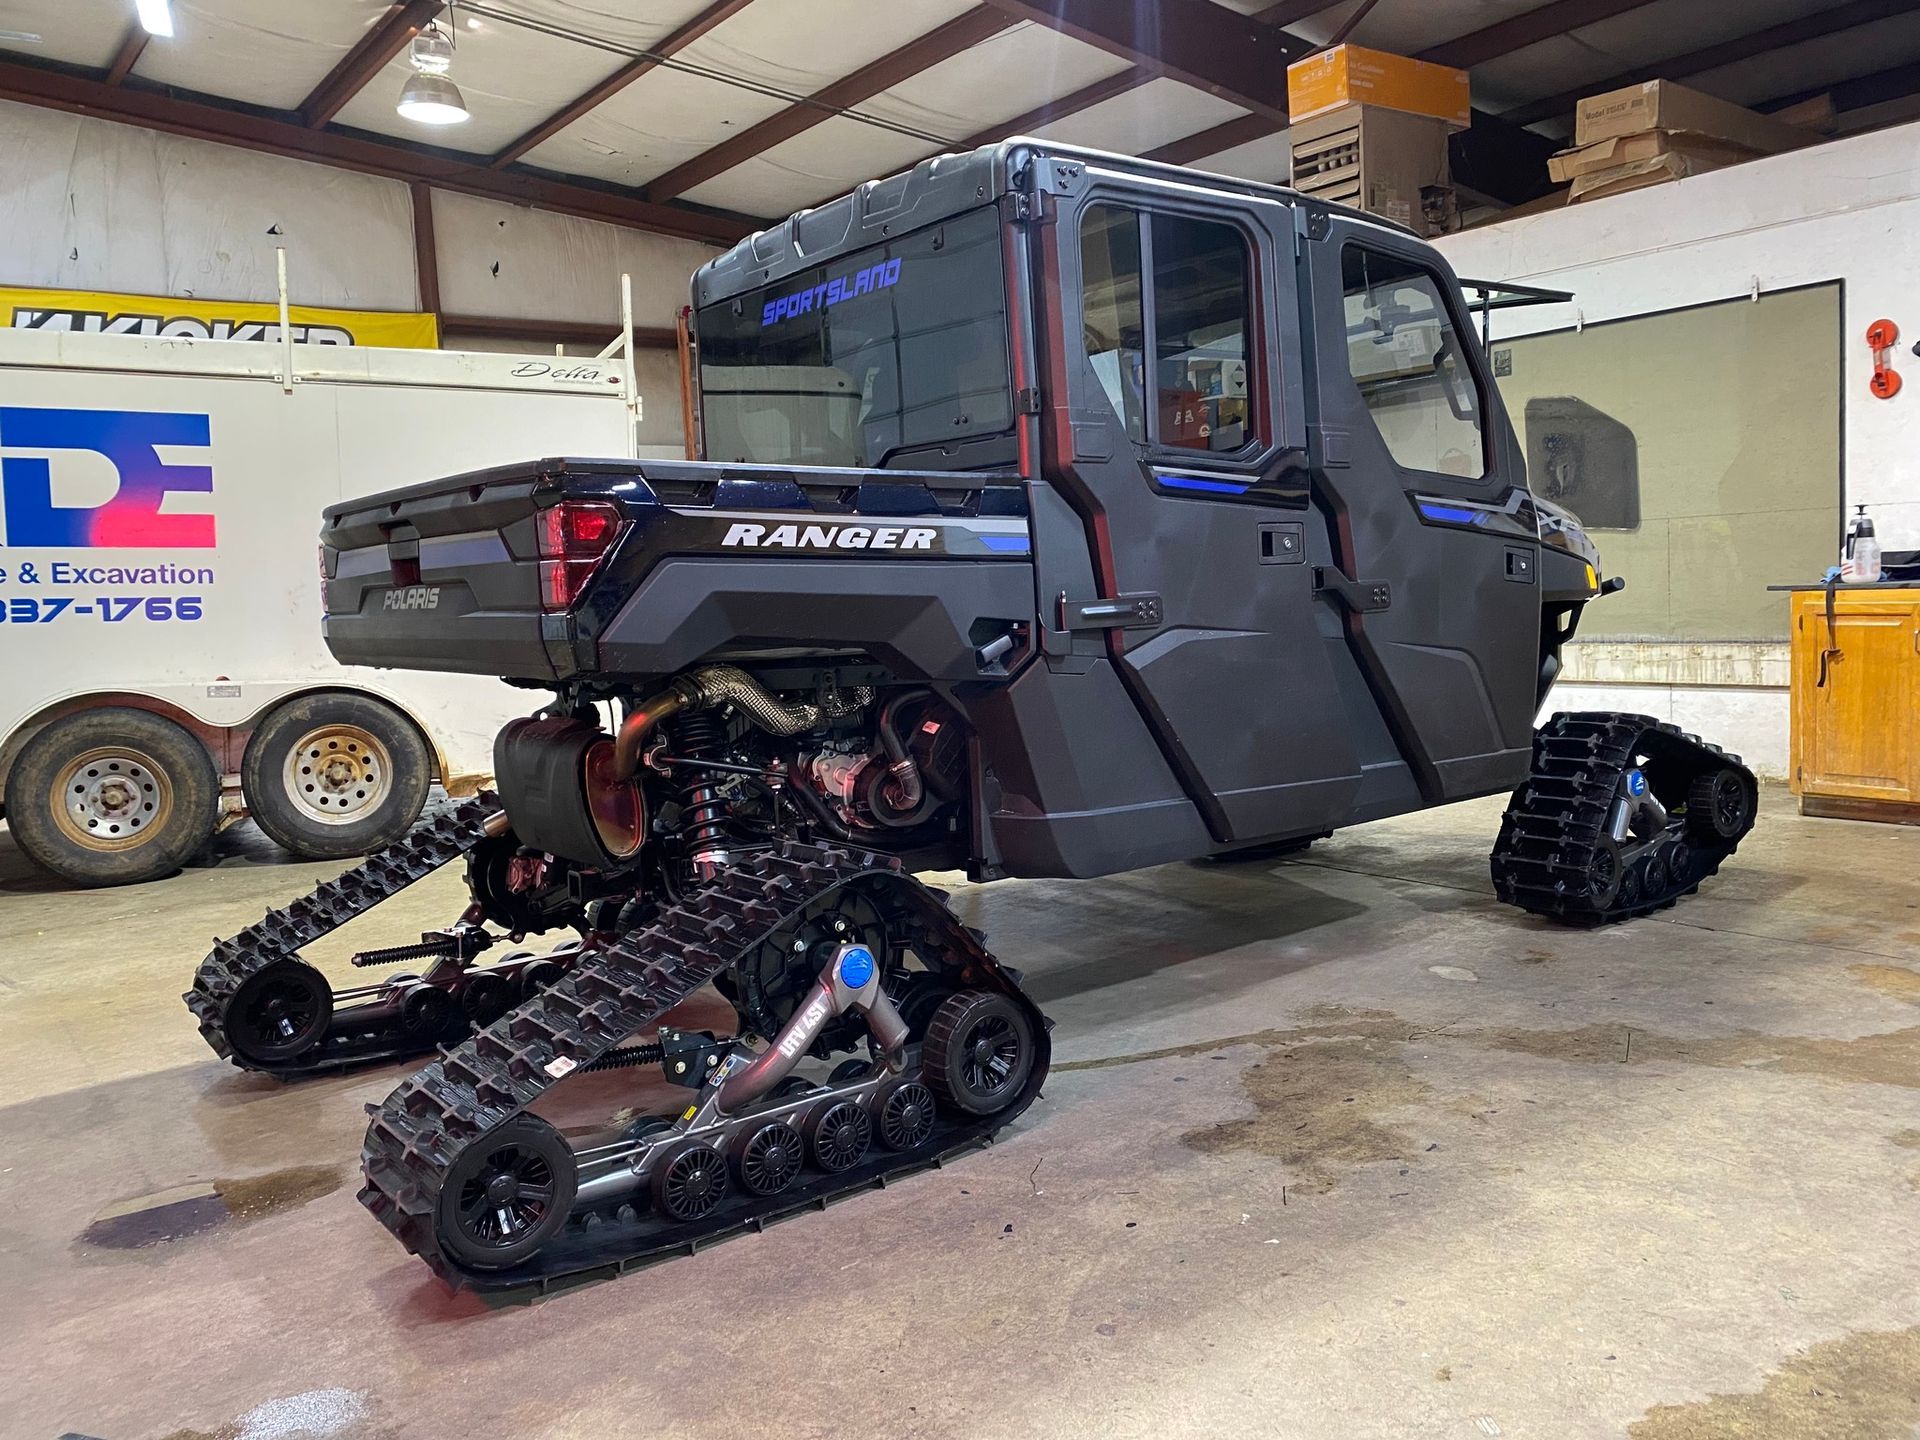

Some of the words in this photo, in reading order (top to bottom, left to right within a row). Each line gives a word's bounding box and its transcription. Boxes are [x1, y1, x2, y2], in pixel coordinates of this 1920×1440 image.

[762, 257, 902, 326] SPORTSLAND
[510, 362, 600, 380] Delta
[721, 523, 937, 549] RANGER
[18, 562, 41, 585] &
[51, 562, 214, 585] Excavation
[0, 596, 202, 624] 37-1766
[383, 587, 440, 610] POLARIS
[777, 1023, 807, 1058] UTV
